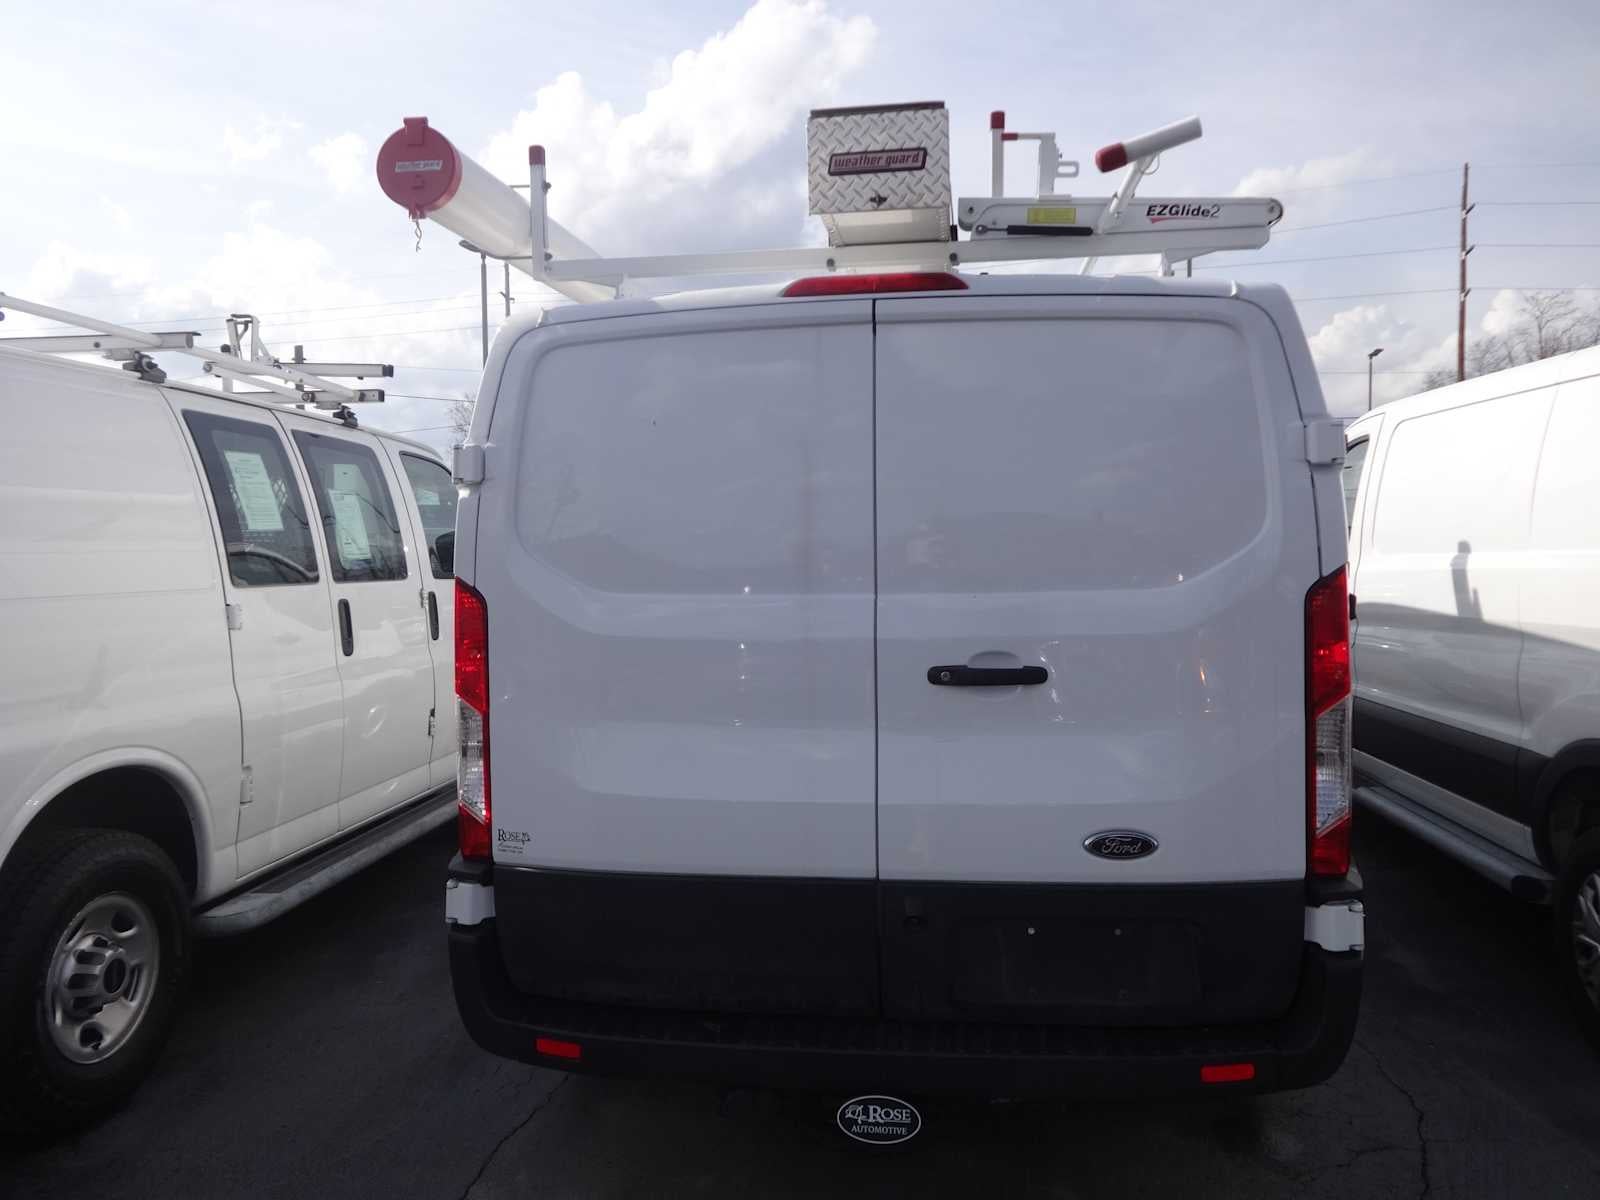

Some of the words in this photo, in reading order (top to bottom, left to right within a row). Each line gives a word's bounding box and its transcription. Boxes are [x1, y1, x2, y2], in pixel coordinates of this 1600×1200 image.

[833, 154, 882, 169] weather
[886, 151, 920, 167] guard
[1146, 203, 1221, 218] EZGlide2
[1102, 837, 1142, 854] Ford
[867, 1105, 911, 1123] ROSE
[851, 1124, 907, 1135] AUTOMOTIVE
